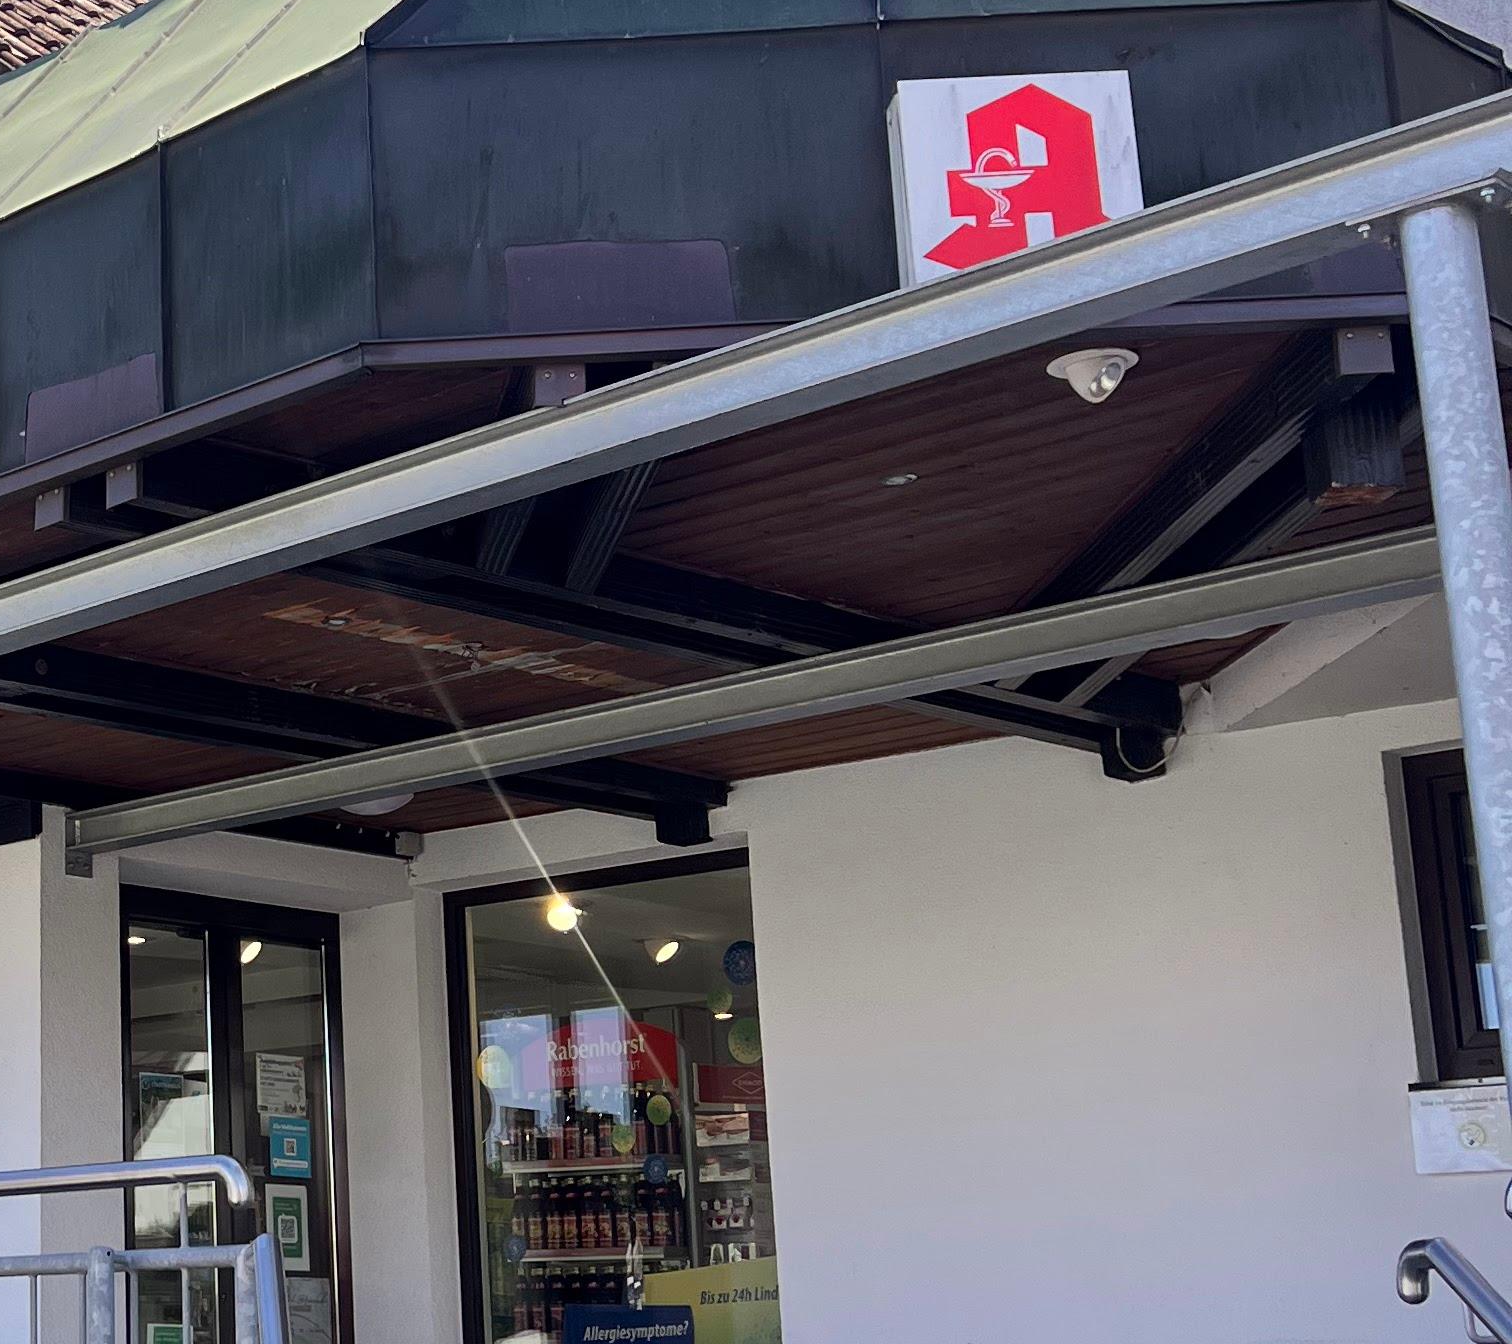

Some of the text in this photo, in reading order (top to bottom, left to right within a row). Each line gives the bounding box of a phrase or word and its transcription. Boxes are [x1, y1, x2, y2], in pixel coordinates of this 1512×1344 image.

[546, 1033, 646, 1061] Rabenhorst
[700, 1290, 715, 1305] Bis
[717, 1294, 729, 1304] zu
[731, 1287, 752, 1303] 24h
[583, 1320, 689, 1343] Allergiesymptome?
